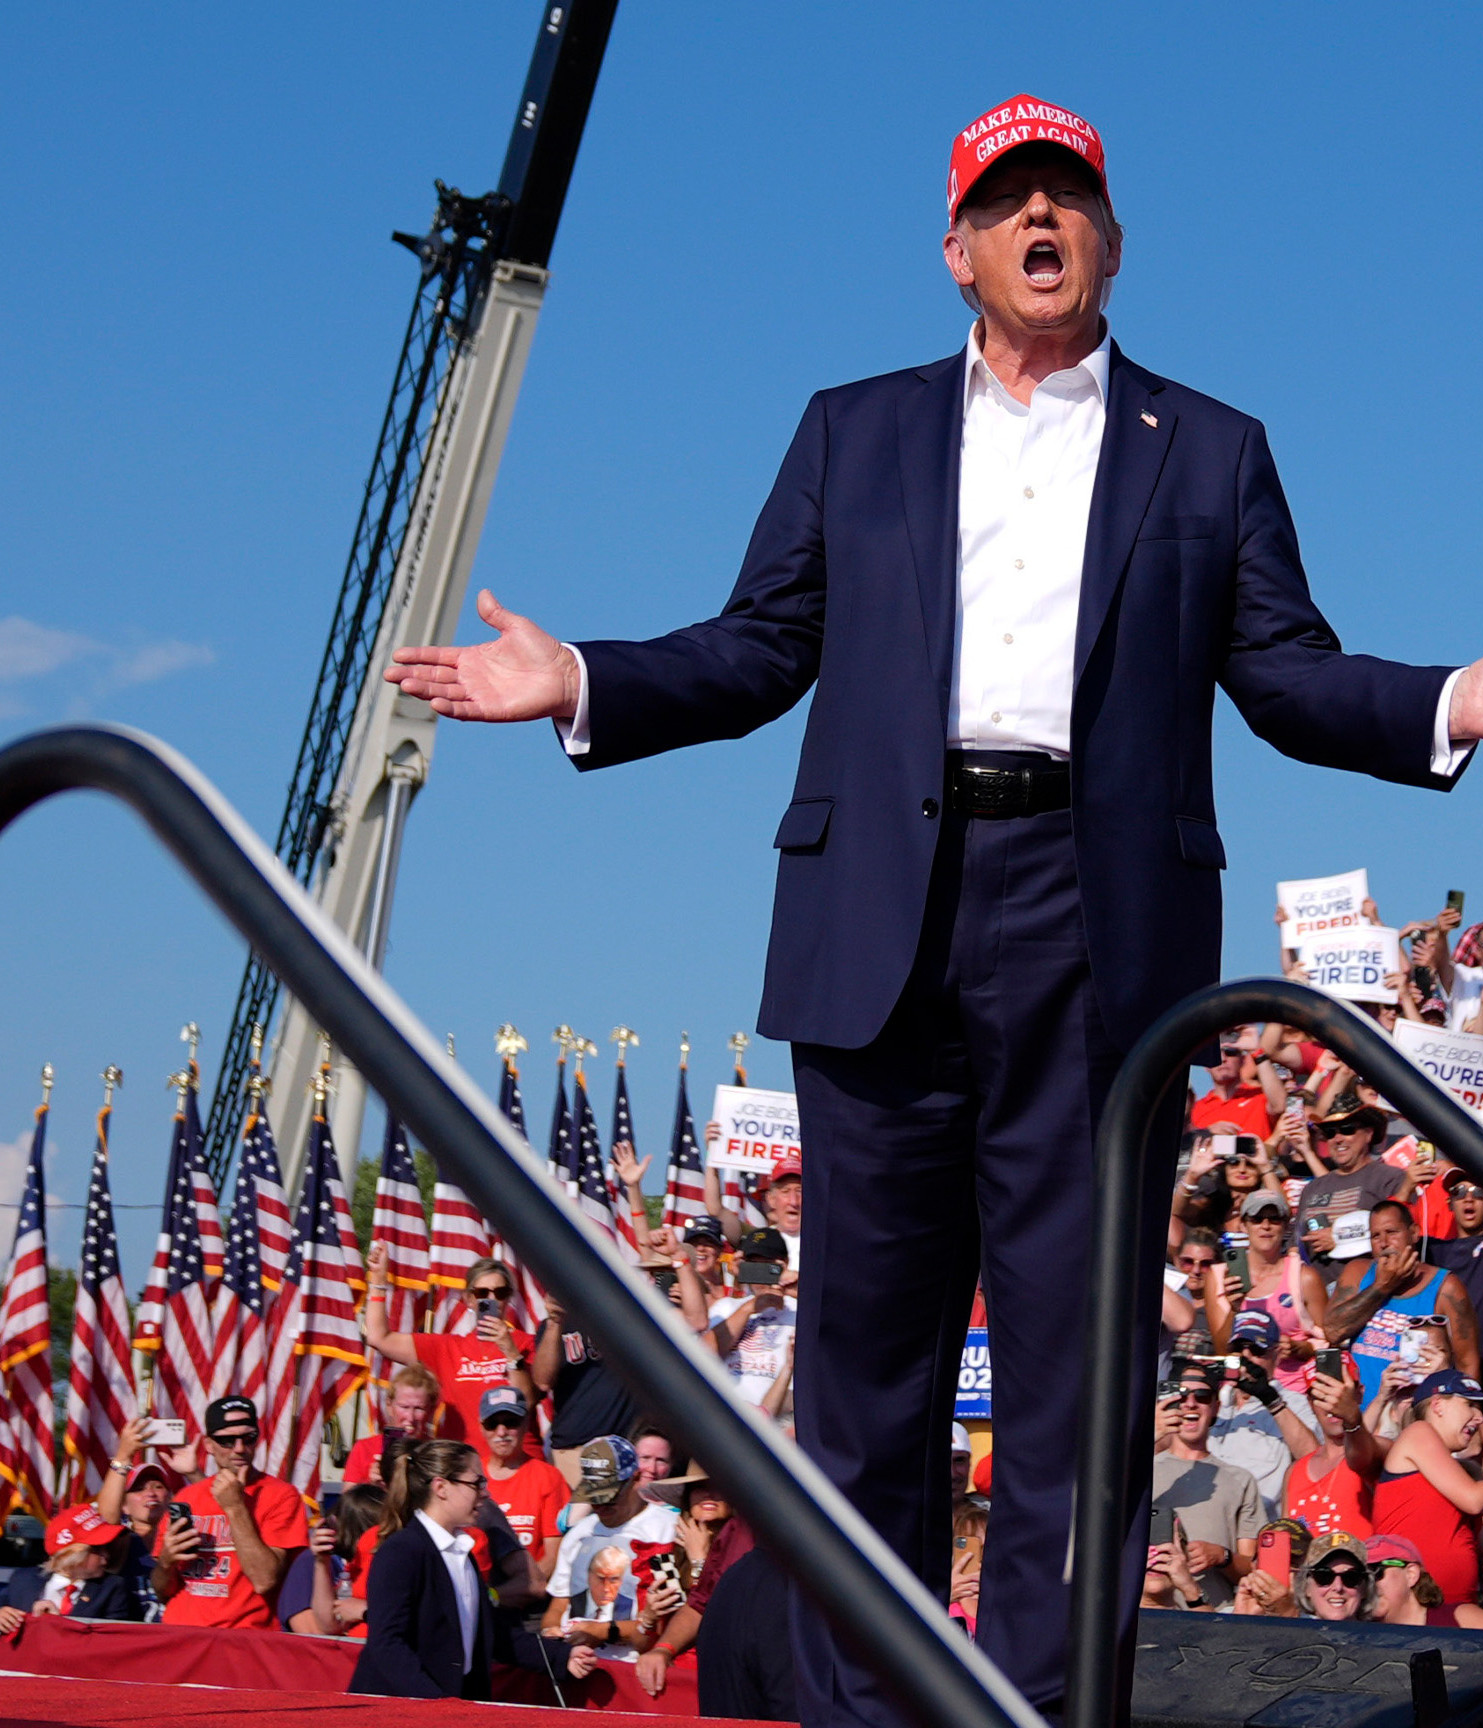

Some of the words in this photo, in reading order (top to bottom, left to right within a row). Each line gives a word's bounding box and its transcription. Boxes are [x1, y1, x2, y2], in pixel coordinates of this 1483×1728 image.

[962, 108, 1012, 148] MAKE
[1014, 104, 1096, 142] AMERICA
[976, 125, 1031, 163] GREAT
[1036, 126, 1088, 156] AGAIN
[1294, 896, 1355, 919] YOU'RE
[1314, 949, 1383, 967] YOU'RE
[1308, 966, 1389, 985] FIRED!
[1415, 1042, 1445, 1060] JOE
[736, 1103, 764, 1117] JOE
[765, 1105, 799, 1121] BIDE
[958, 1368, 991, 1389] 02
